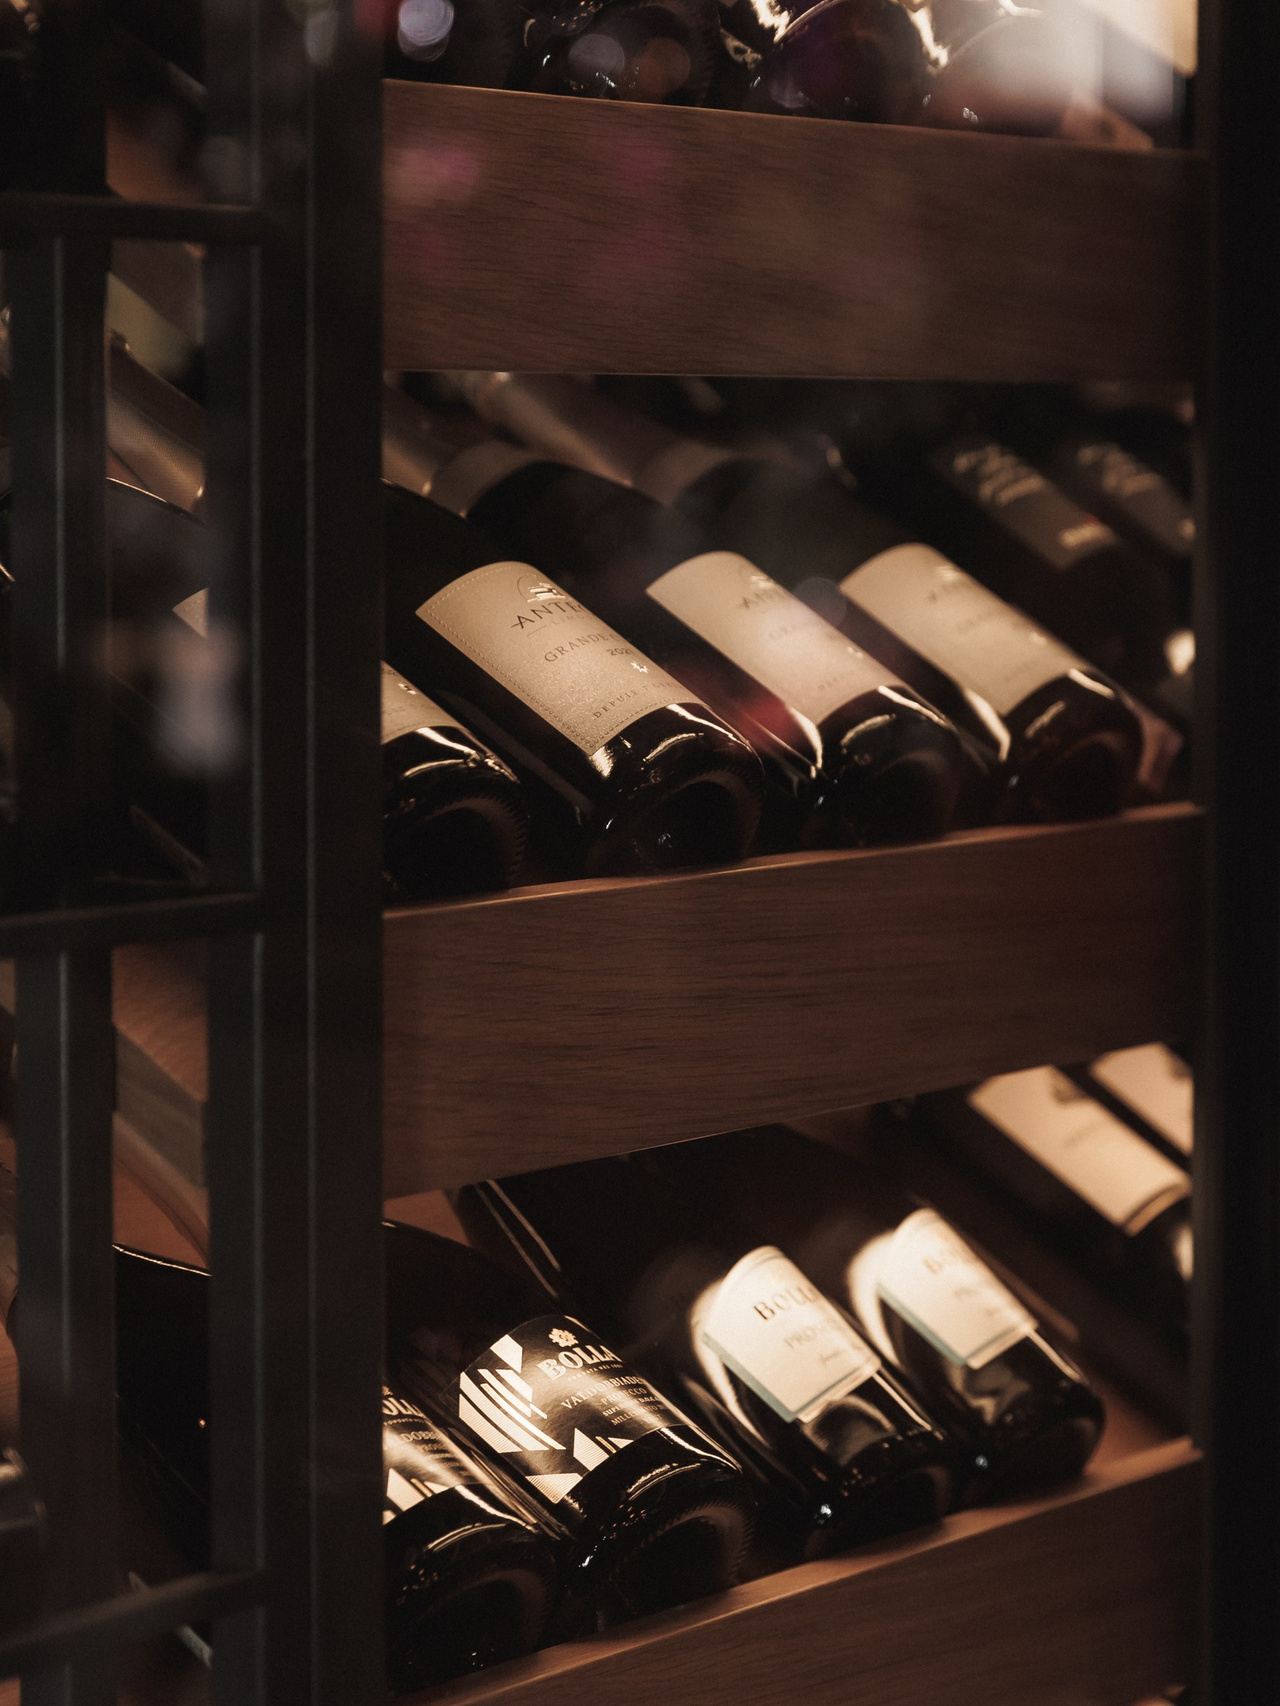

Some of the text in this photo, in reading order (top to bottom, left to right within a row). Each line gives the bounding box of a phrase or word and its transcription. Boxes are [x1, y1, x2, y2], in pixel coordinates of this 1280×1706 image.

[544, 633, 609, 662] GRANDE
[593, 690, 638, 719] DEPUIS
[536, 1345, 624, 1381] BOLLA
[561, 1376, 645, 1409] VALDOBBIADE
[601, 1387, 648, 1405] PROSECCO
